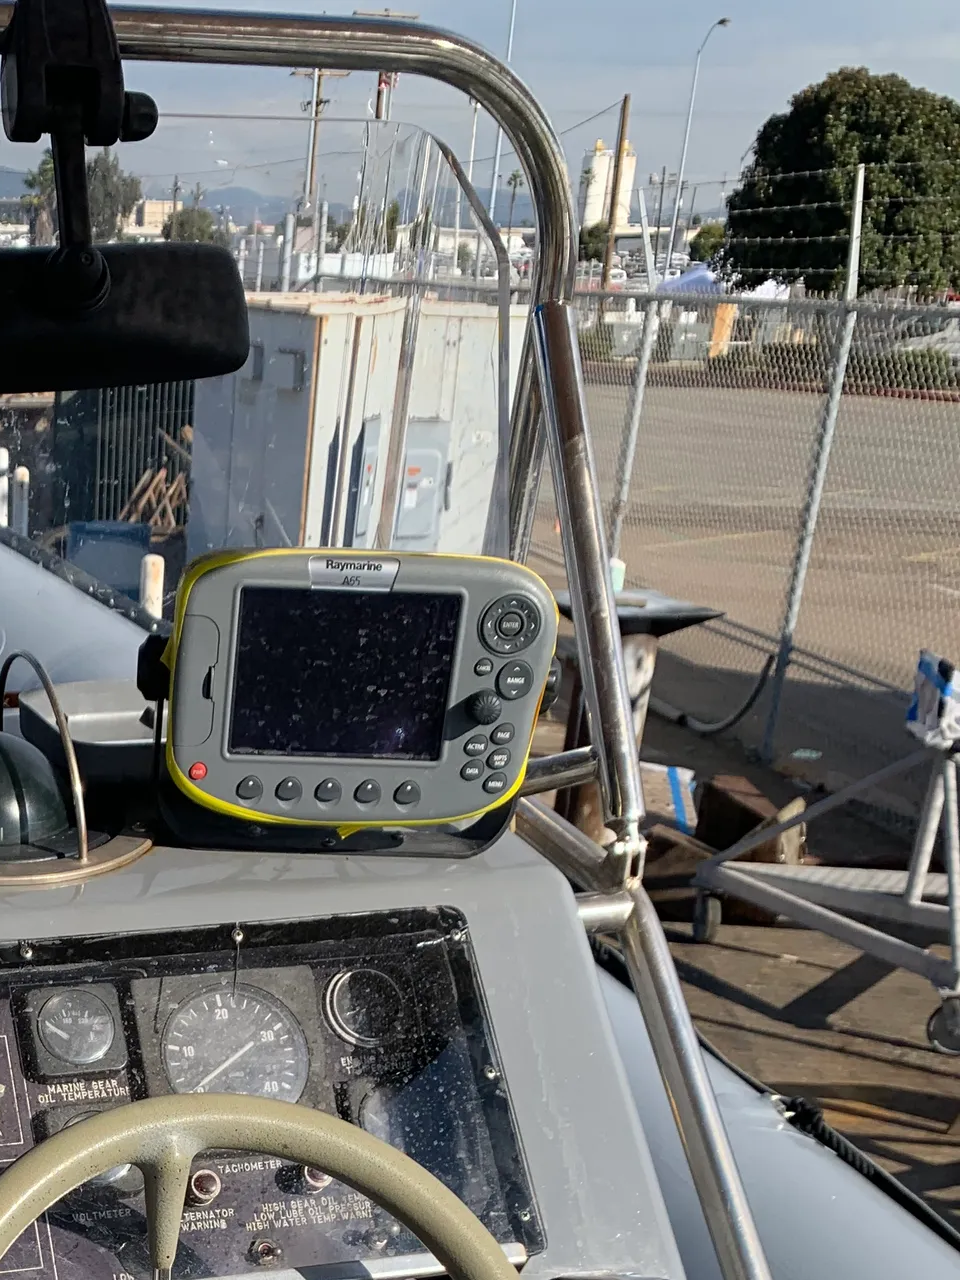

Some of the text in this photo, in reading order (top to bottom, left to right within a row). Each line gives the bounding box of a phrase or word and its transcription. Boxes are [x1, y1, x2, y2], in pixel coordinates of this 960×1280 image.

[325, 559, 382, 571] Raymarine
[341, 575, 361, 586] A65
[506, 676, 525, 684] RANGE
[496, 731, 511, 739] PAGE
[214, 1008, 228, 1020] 20
[260, 1030, 274, 1042] 30
[183, 1045, 195, 1057] 10
[47, 1079, 118, 1094] MARINE GEAR
[264, 1080, 279, 1093] 40
[38, 1093, 56, 1104] OIL
[217, 1159, 282, 1174] TACHOMETER
[261, 1201, 285, 1213] HIGH
[290, 1198, 316, 1210] GEAR
[321, 1195, 338, 1206] OIL
[72, 1208, 131, 1222] VOLTMETER
[180, 1208, 235, 1222] TERNATOR
[253, 1201, 372, 1222] LOW LUBE OIL PRESSUR
[181, 1219, 227, 1231] WARNING
[245, 1221, 270, 1232] HIGH
[274, 1217, 307, 1228] WATER
[341, 1209, 373, 1220] WARNI
